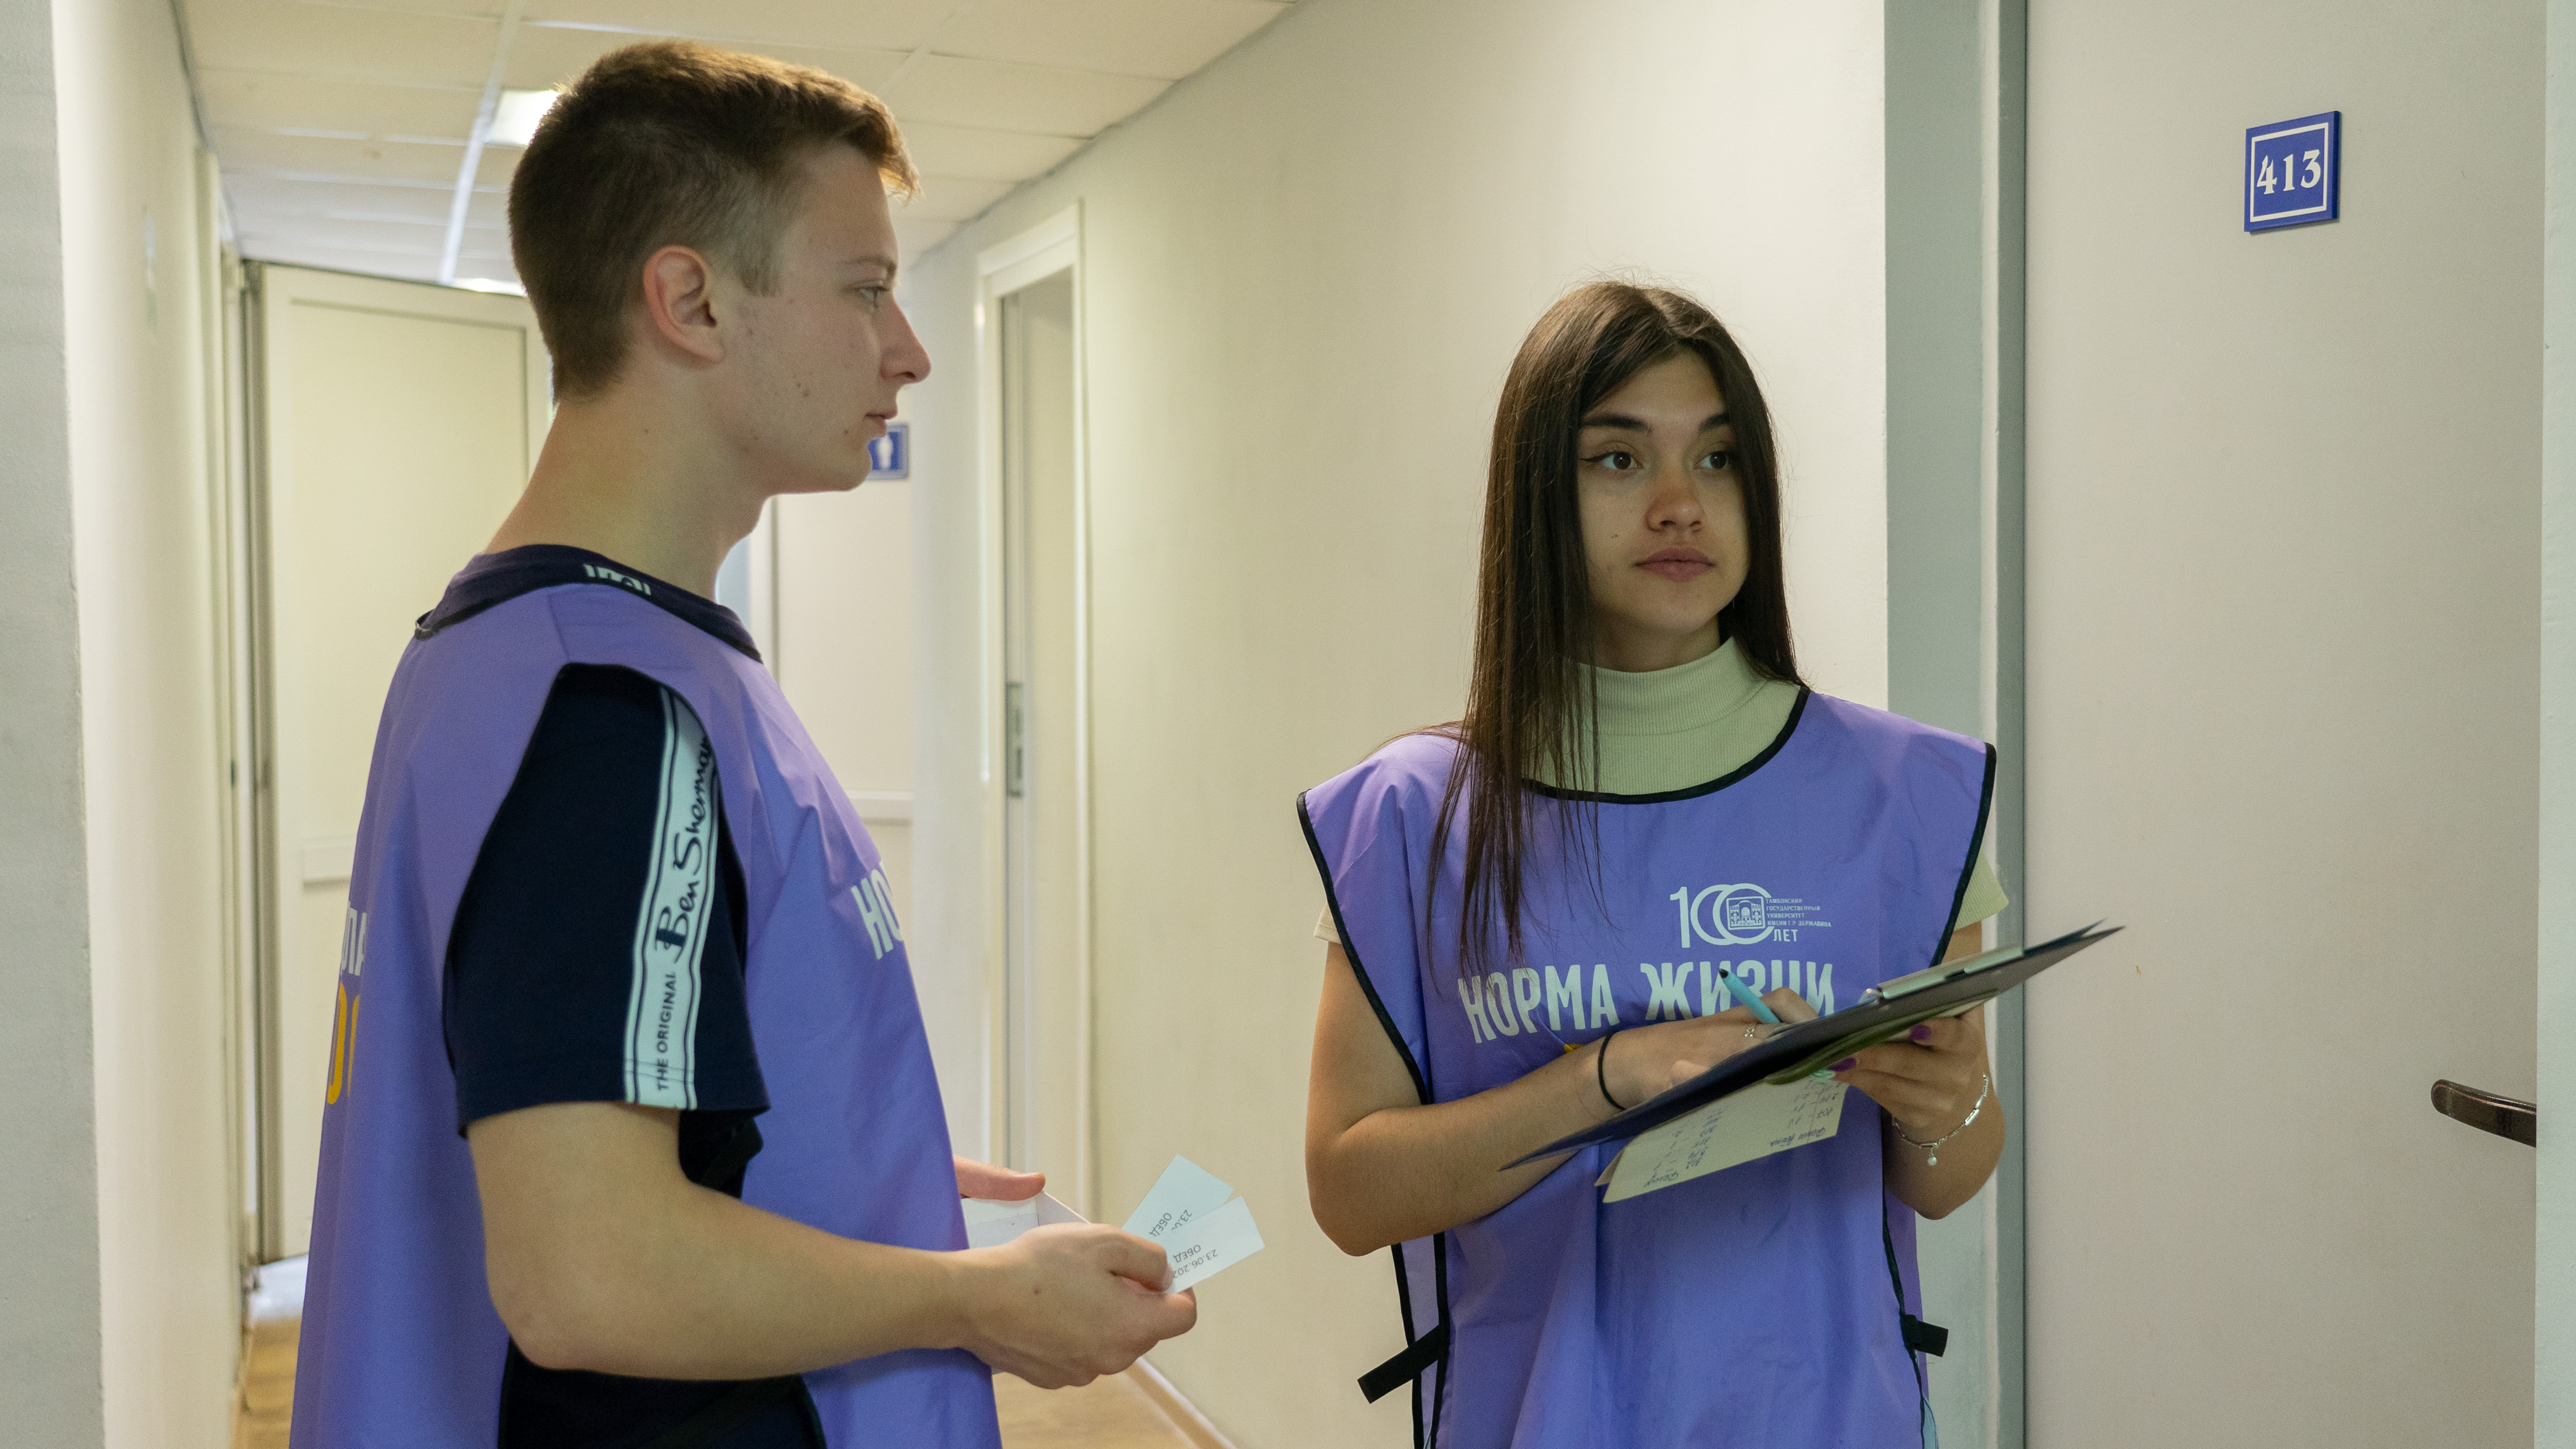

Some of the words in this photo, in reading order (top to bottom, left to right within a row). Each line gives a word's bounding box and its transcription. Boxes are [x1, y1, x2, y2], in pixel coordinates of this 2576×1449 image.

[2257, 149, 2321, 195] 413
[655, 881, 700, 964] Ben
[1773, 929, 1799, 942] ЛЕТ
[656, 971, 676, 1053] ORIGINAL
[1458, 964, 1620, 1043] НОРМА
[656, 1058, 669, 1091] THE
[1148, 1212, 1172, 1237] ОБЕД
[1172, 1249, 1218, 1278] 23.06.202
[1173, 1244, 1201, 1263] ОБЕД
